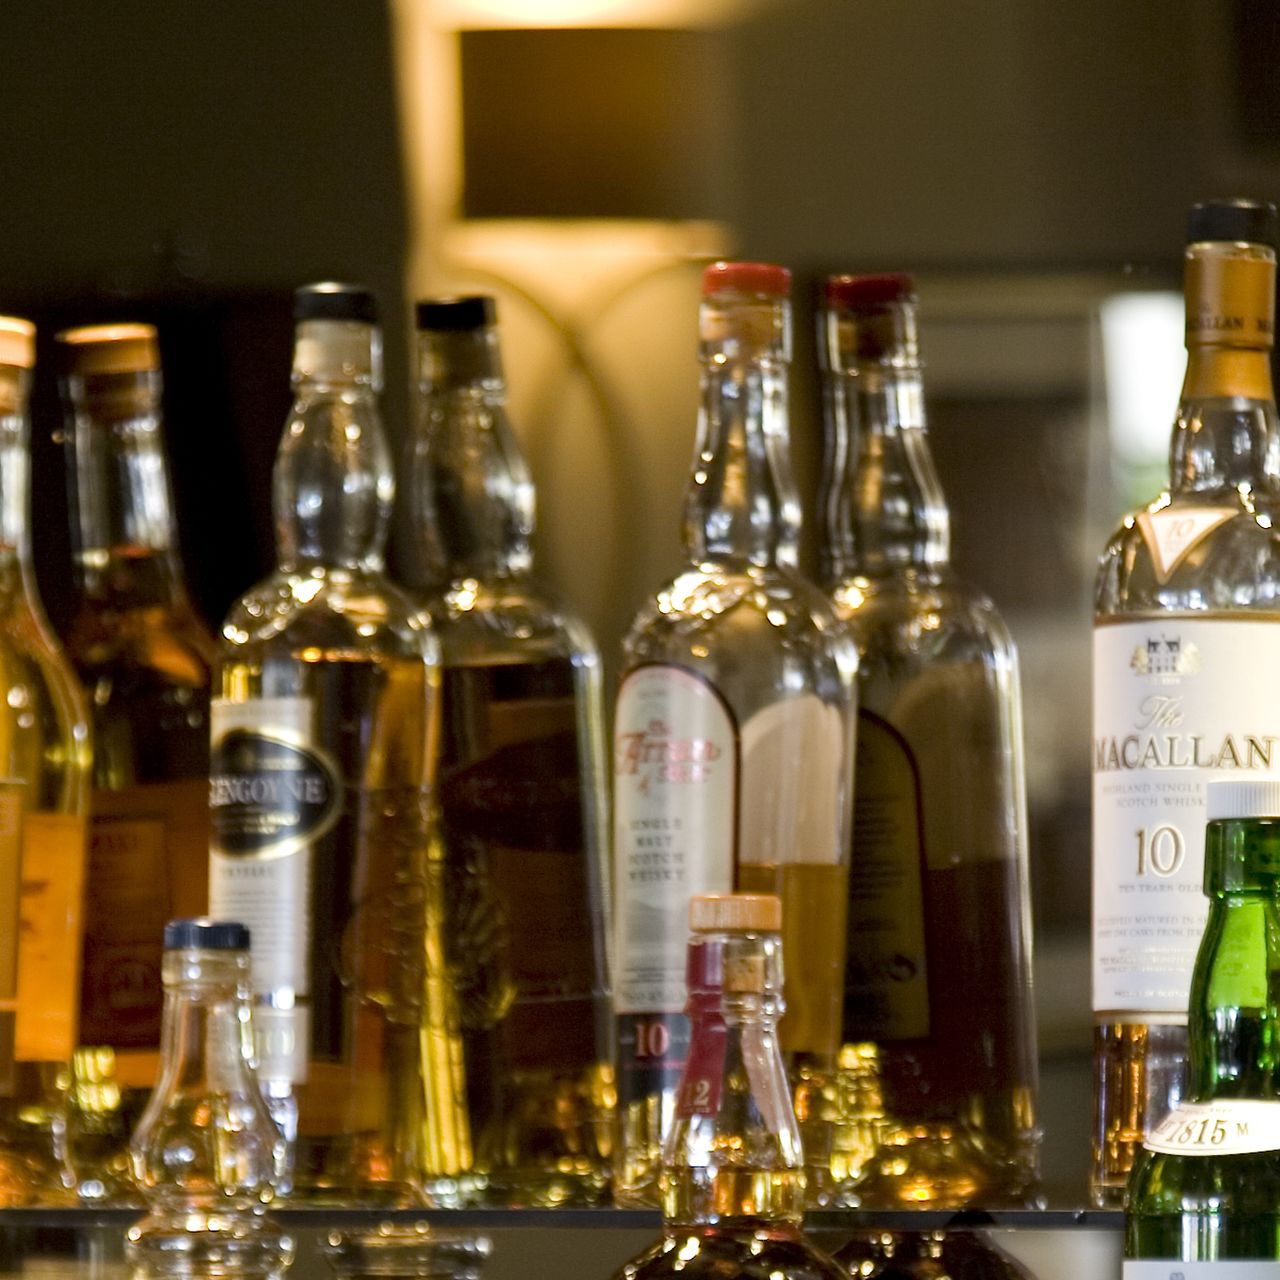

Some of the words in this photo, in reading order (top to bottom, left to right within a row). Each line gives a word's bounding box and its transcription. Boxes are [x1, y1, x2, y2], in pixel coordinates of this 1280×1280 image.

[1135, 697, 1183, 730] The
[1163, 796, 1206, 808] WHISK
[1135, 825, 1186, 877] 10
[635, 1023, 670, 1058] 10
[1164, 1118, 1230, 1145] 1815
